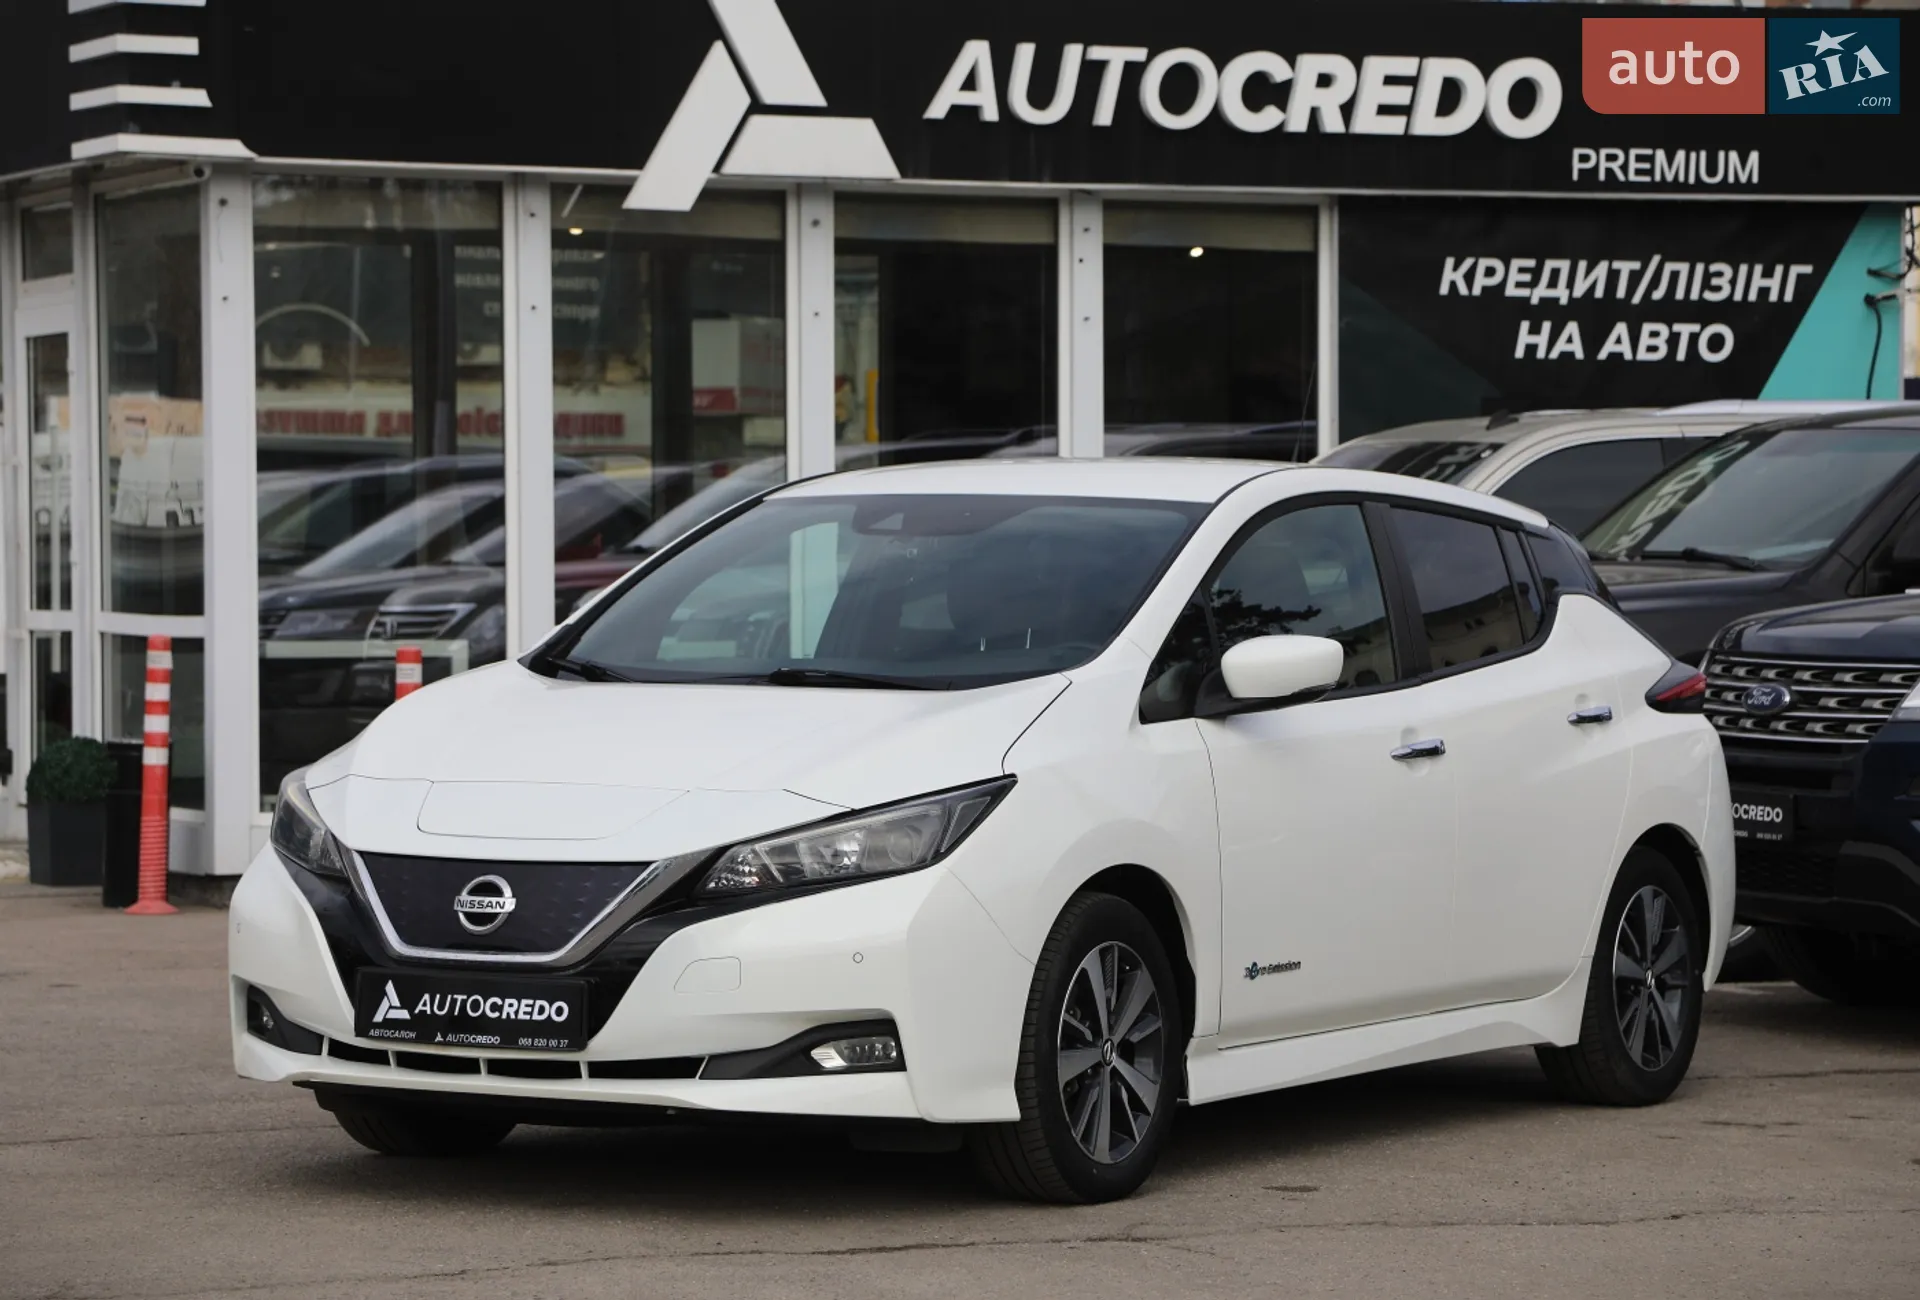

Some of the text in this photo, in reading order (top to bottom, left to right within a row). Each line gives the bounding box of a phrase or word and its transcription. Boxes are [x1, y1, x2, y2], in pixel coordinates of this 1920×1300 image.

[923, 39, 1563, 139] AUTOCREDO
[1571, 148, 1760, 185] PREMIUM
[1439, 254, 1813, 305] КРЕДИТ/ЛІЗІНГ
[1514, 319, 1735, 363] НА АВТО
[1746, 687, 1776, 706] Ford
[1732, 803, 1783, 823] OCREDO
[456, 899, 506, 910] NISSAN
[414, 992, 570, 1023] AUTOCREDO
[368, 1028, 417, 1039] АВТОСАЛОН
[446, 1033, 501, 1045] AUTOCREDO
[518, 1036, 569, 1048] 068 820 00 37
